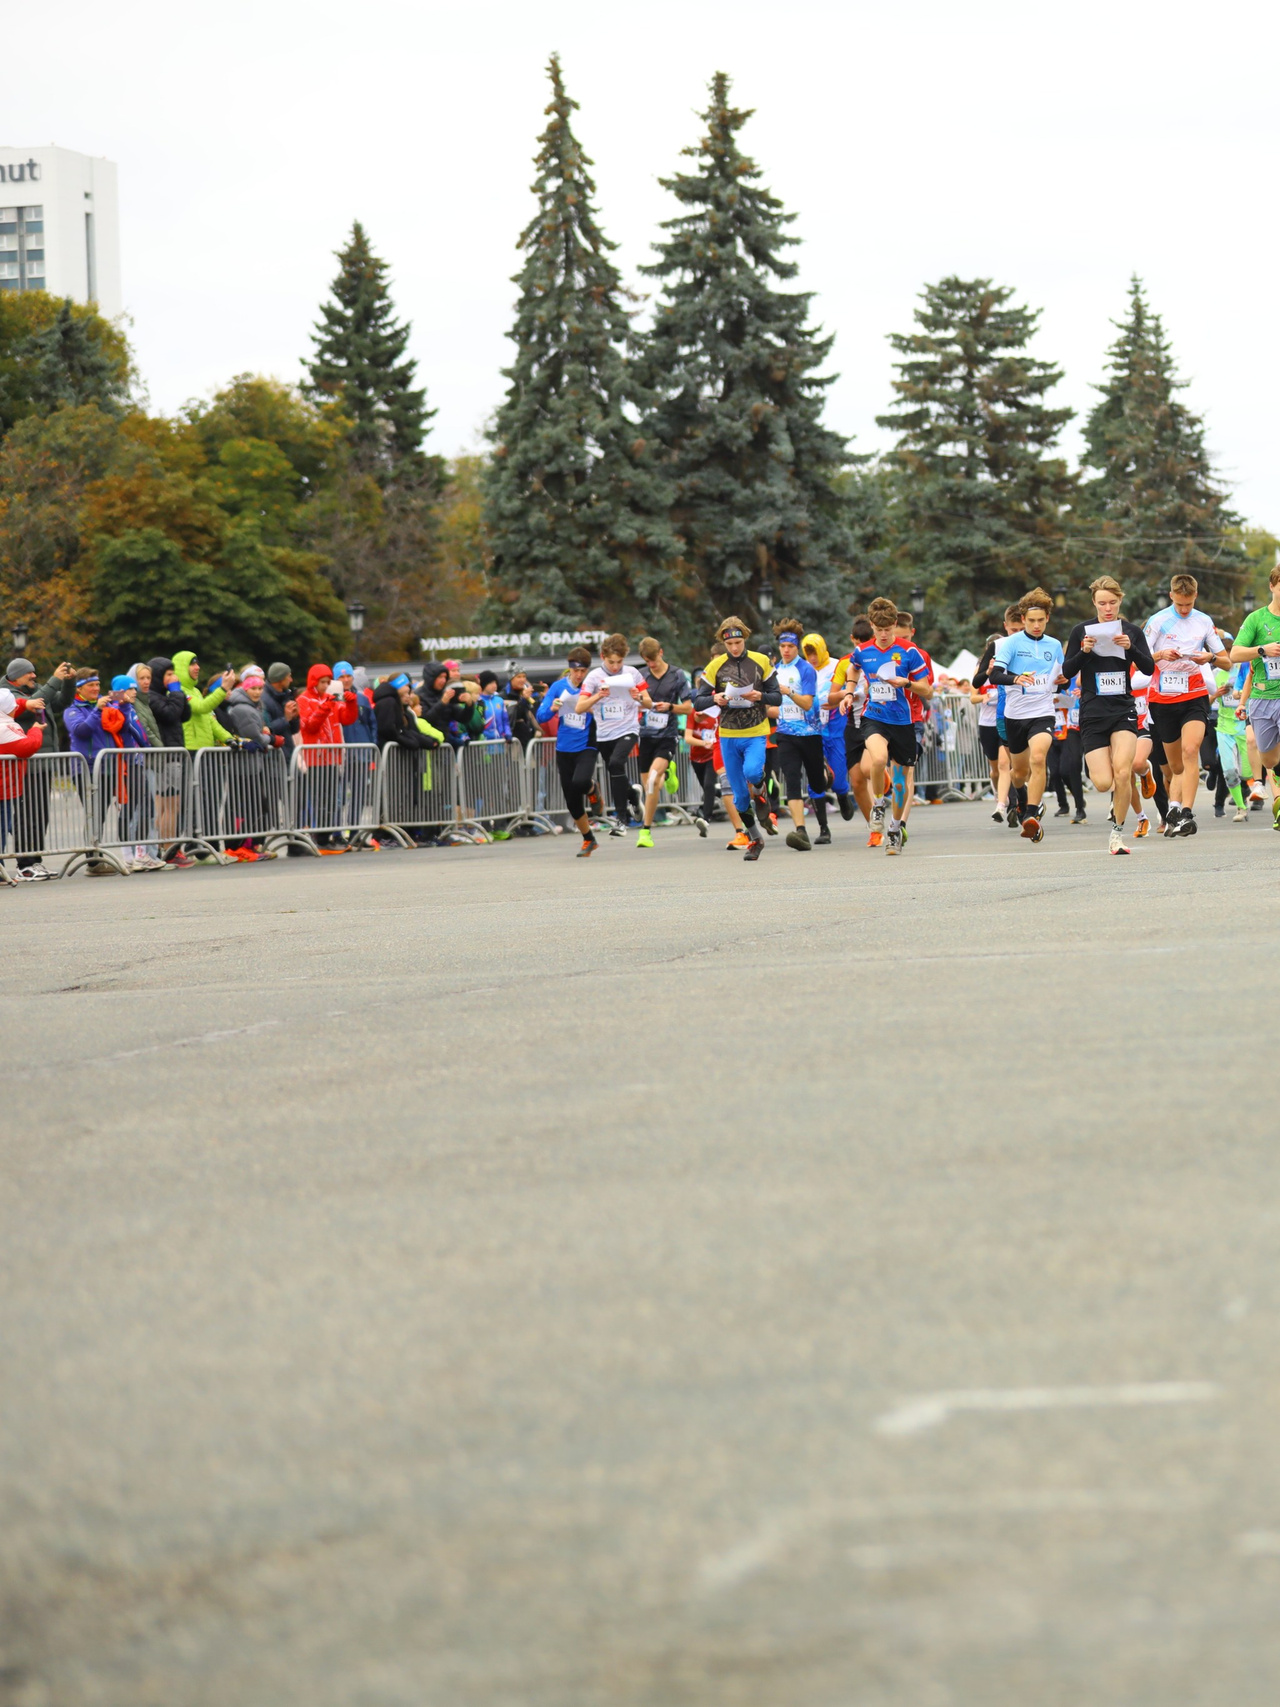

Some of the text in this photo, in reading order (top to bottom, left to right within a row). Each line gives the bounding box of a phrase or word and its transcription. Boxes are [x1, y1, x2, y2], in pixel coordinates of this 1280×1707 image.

[420, 630, 609, 651] УЛЬЯНОВСКАЯ ОБЛАСТЬ
[1100, 678, 1122, 686] 308.1
[1163, 675, 1184, 684] 327.1
[872, 686, 891, 694] 302.1
[604, 706, 622, 714] 342.1
[783, 706, 799, 714] 305.1
